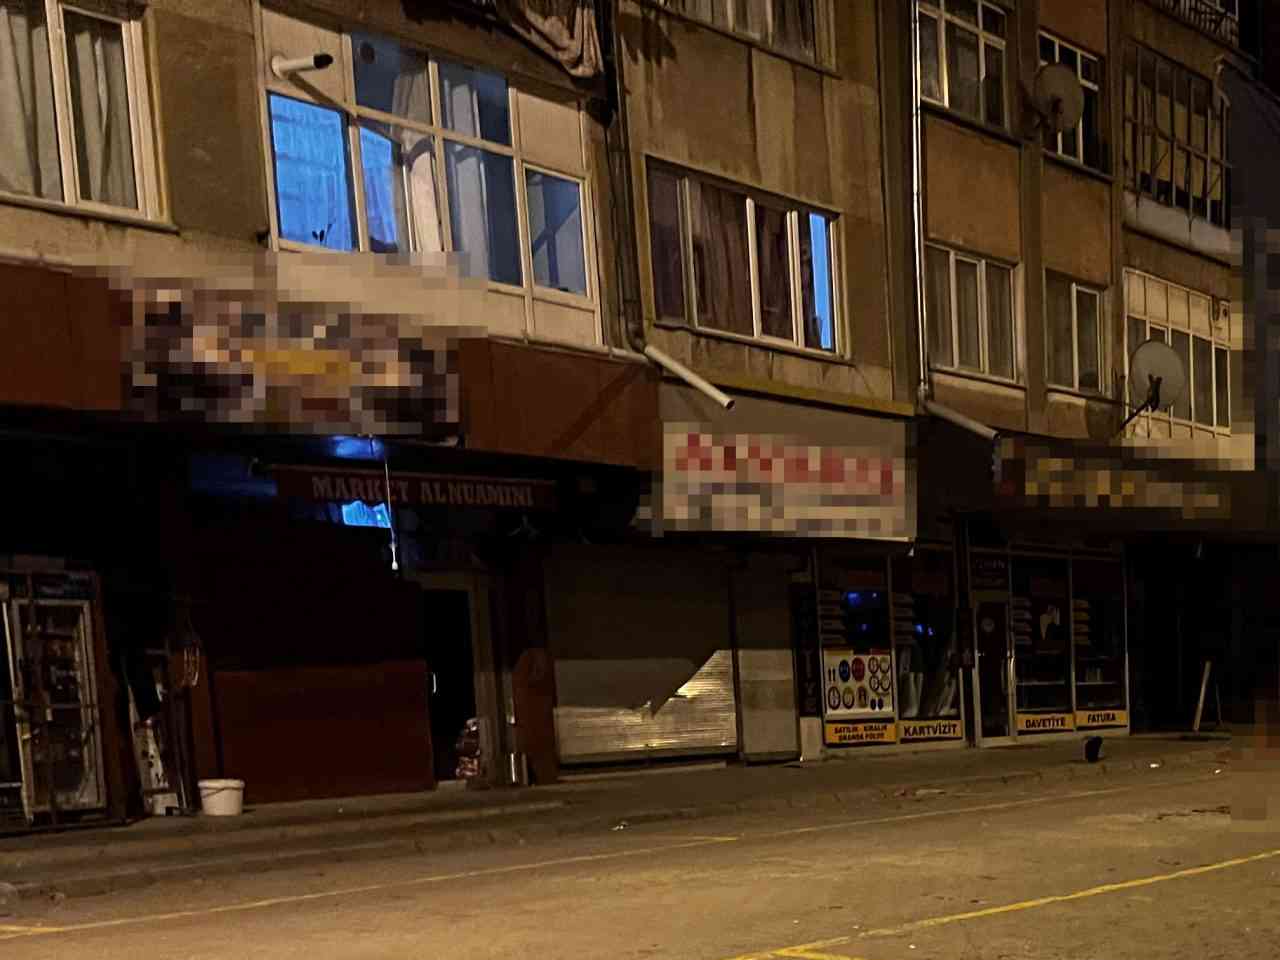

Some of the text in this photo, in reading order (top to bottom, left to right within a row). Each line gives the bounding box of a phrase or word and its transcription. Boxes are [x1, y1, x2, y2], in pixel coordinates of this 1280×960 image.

[312, 475, 408, 503] MARKET
[1087, 712, 1116, 724] FATURA
[904, 720, 957, 737] KARTVİZİT
